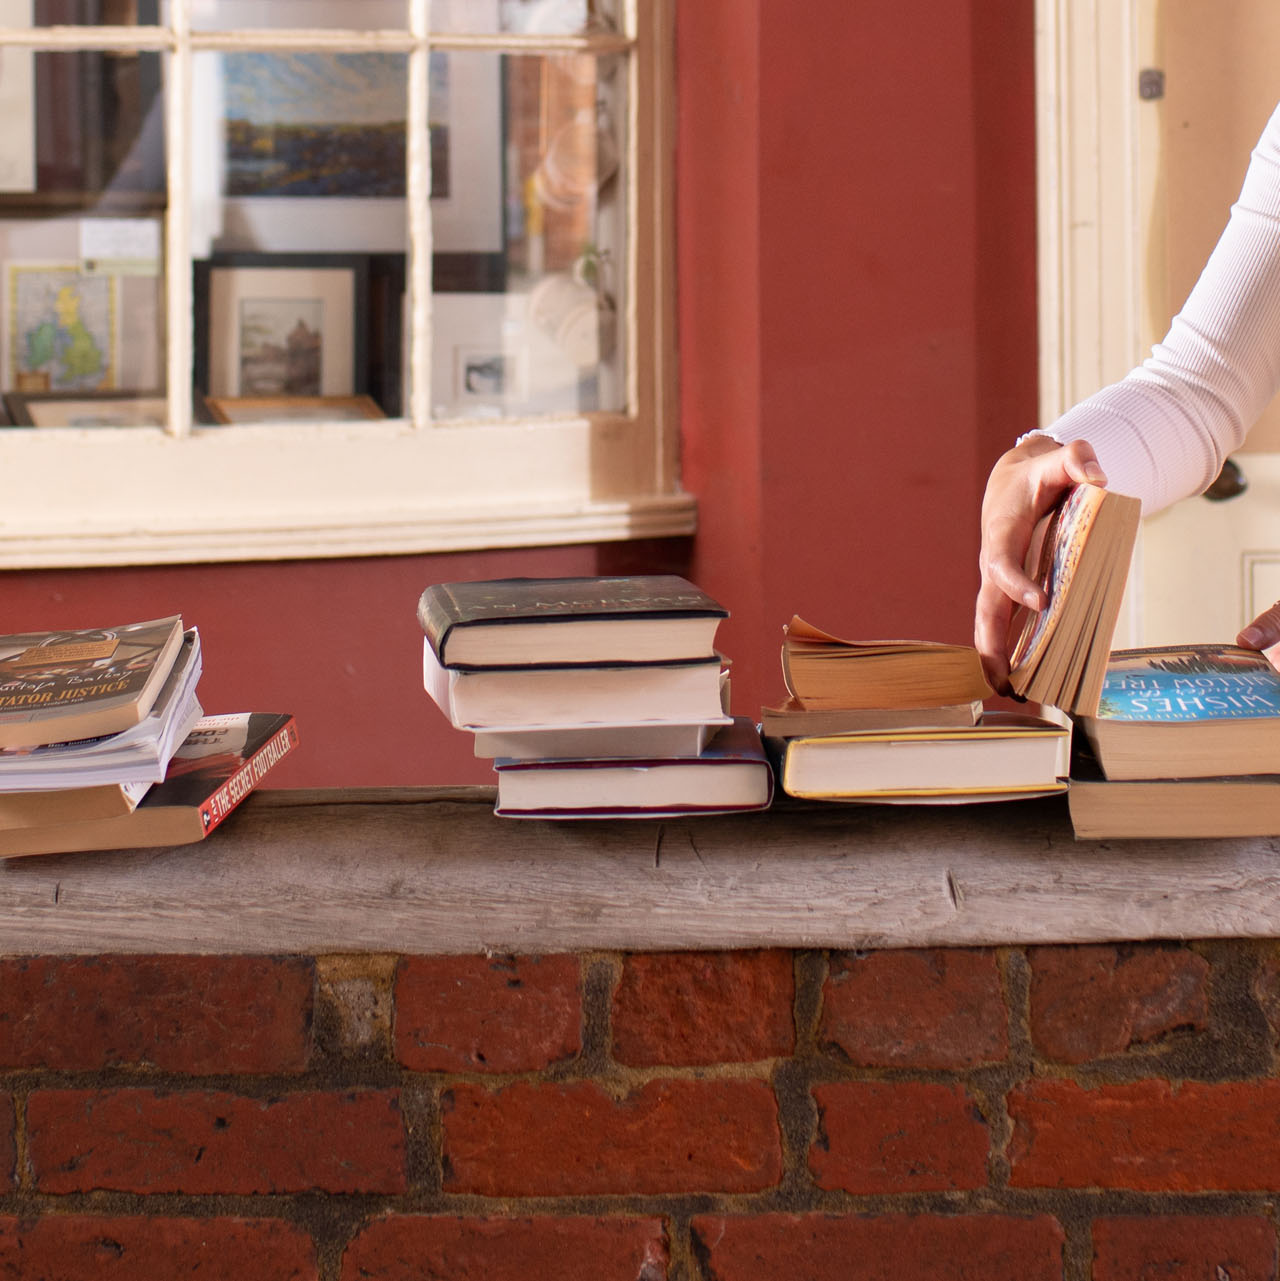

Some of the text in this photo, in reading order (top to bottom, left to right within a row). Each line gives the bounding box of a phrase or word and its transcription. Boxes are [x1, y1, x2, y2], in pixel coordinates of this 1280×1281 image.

[54, 679, 130, 701] JUSTICE
[1173, 676, 1278, 689] WILLOW
[1130, 694, 1275, 713] WISHES
[215, 789, 232, 817] THE
[228, 763, 256, 805] SECRET
[252, 727, 291, 782] FOOTBALLER
